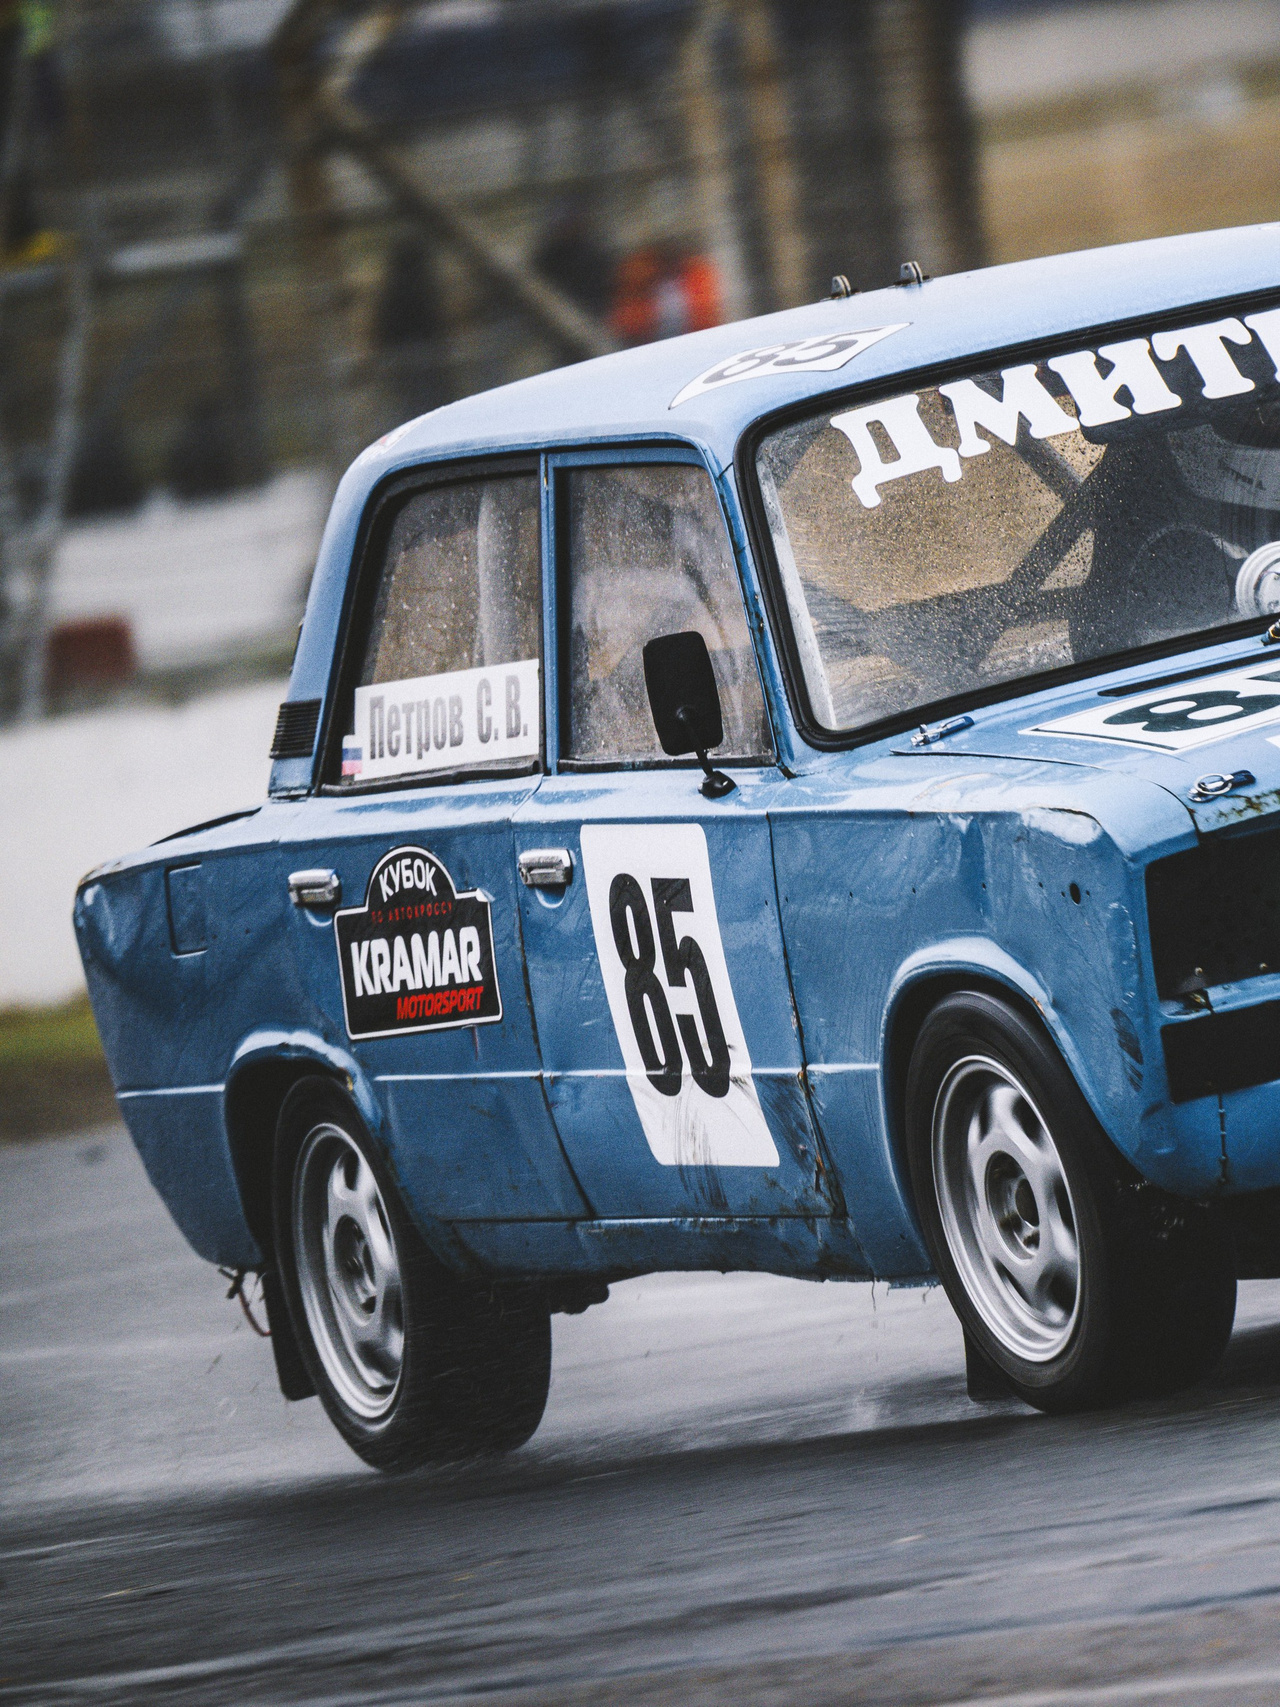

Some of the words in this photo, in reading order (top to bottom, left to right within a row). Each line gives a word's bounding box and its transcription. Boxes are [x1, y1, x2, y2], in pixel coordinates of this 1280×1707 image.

[702, 326, 888, 385] 85
[369, 693, 465, 760] Петров
[379, 858, 438, 902] КУБОК
[388, 901, 453, 923] АВТОКРОССУ
[350, 926, 484, 998] KRAMAR
[608, 872, 731, 1099] 85
[396, 985, 485, 1021] MOTORSPORT
